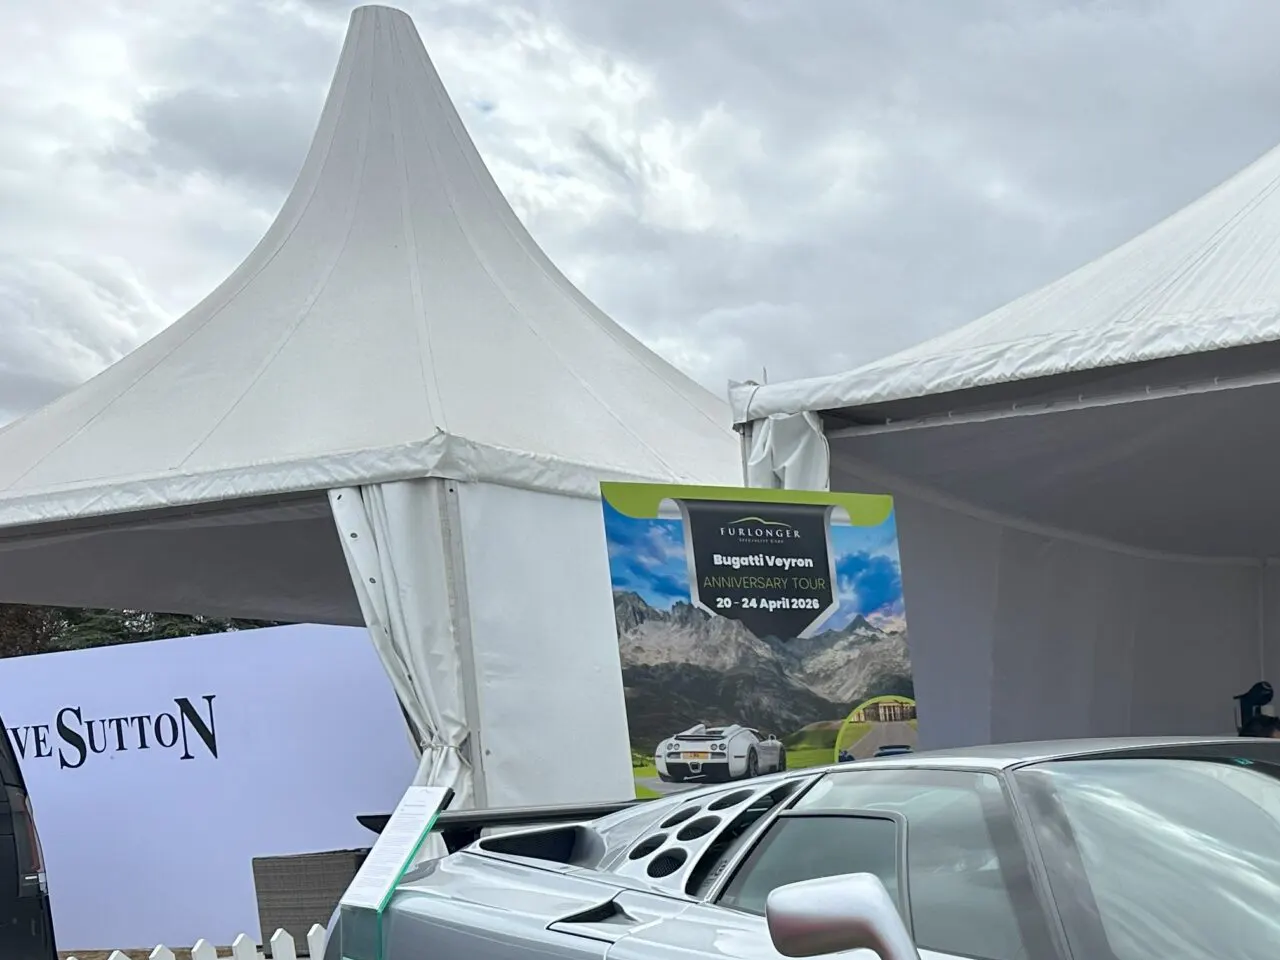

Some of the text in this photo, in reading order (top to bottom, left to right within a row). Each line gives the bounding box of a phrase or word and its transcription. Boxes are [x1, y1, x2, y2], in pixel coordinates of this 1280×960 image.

[720, 527, 801, 538] FURLONGER
[713, 554, 814, 570] Bugatti Veyron
[703, 576, 826, 590] ANNIVERSARY TOUR
[716, 597, 732, 608] 20
[741, 597, 758, 609] 24
[759, 597, 790, 612] April
[791, 598, 820, 609] 2026
